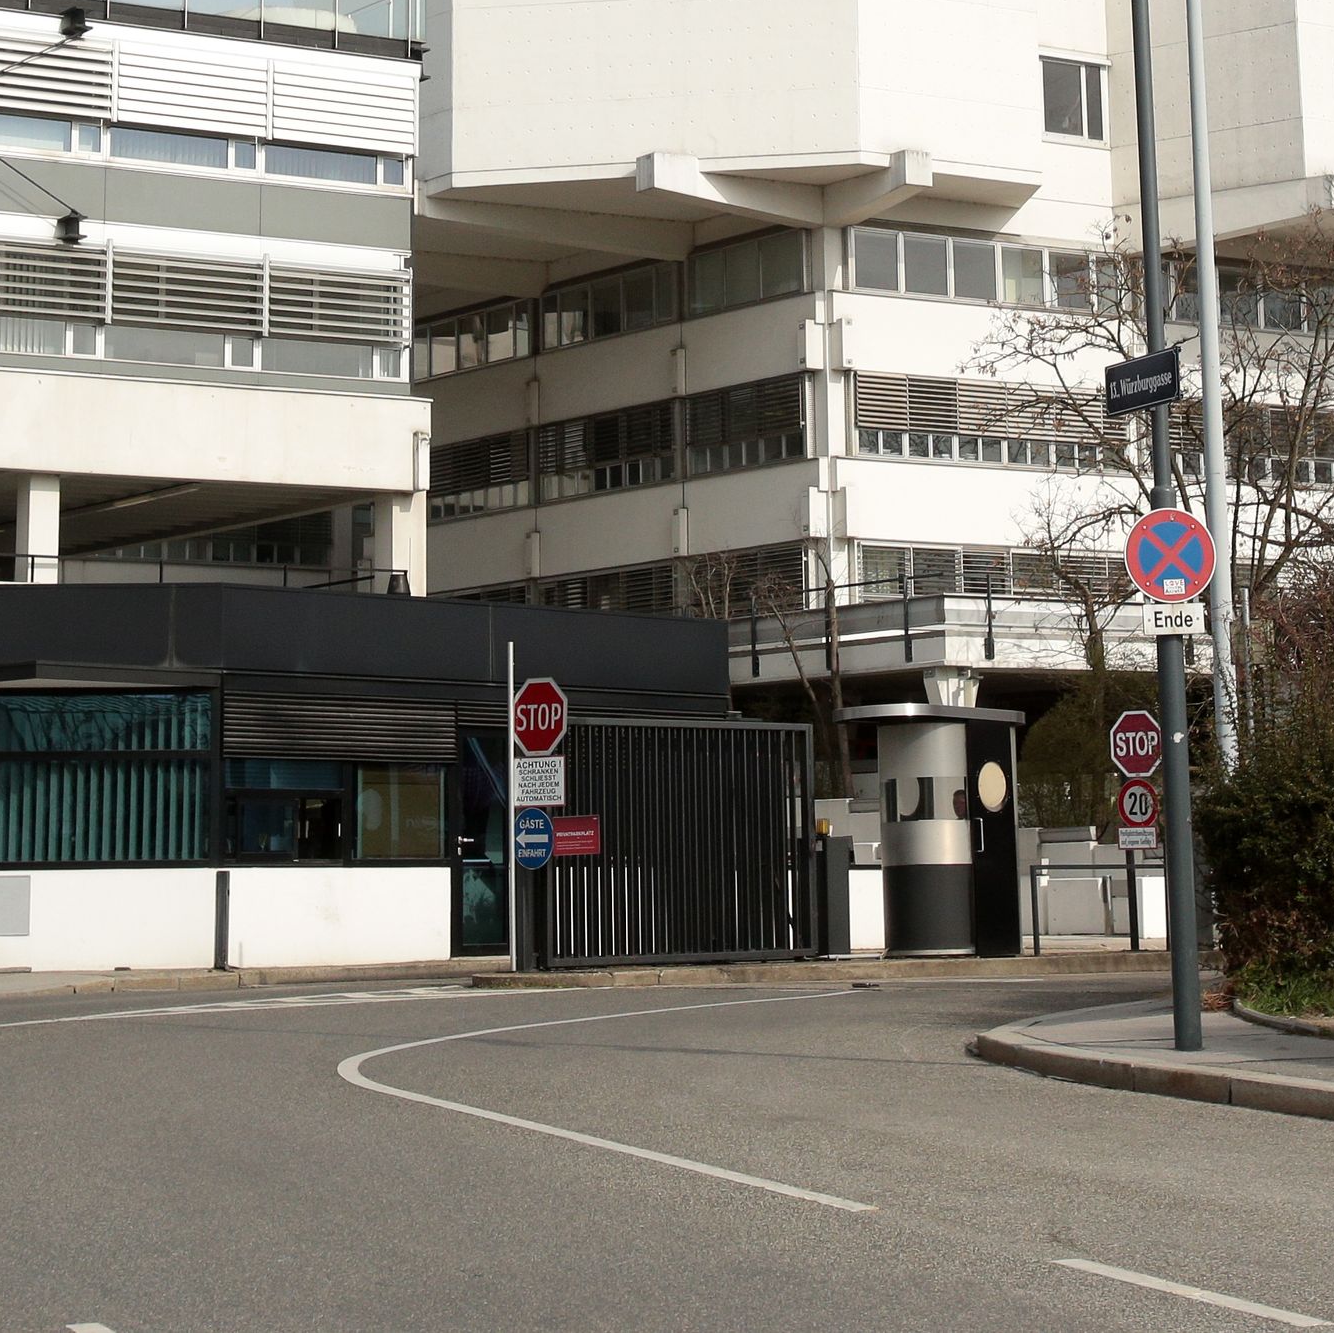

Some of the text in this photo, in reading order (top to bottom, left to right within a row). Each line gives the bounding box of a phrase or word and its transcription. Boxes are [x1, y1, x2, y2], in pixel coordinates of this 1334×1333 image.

[1120, 372, 1172, 396] Würzburggasse
[1154, 610, 1193, 628] Ende
[516, 703, 562, 731] STOP
[1116, 731, 1158, 757] STOP
[516, 761, 556, 769] ACHTUNG
[516, 794, 562, 802] AUTOMATISCH
[1129, 792, 1148, 816] 20
[519, 818, 544, 829] GÄSTE
[518, 848, 546, 858] EINFAHRT
